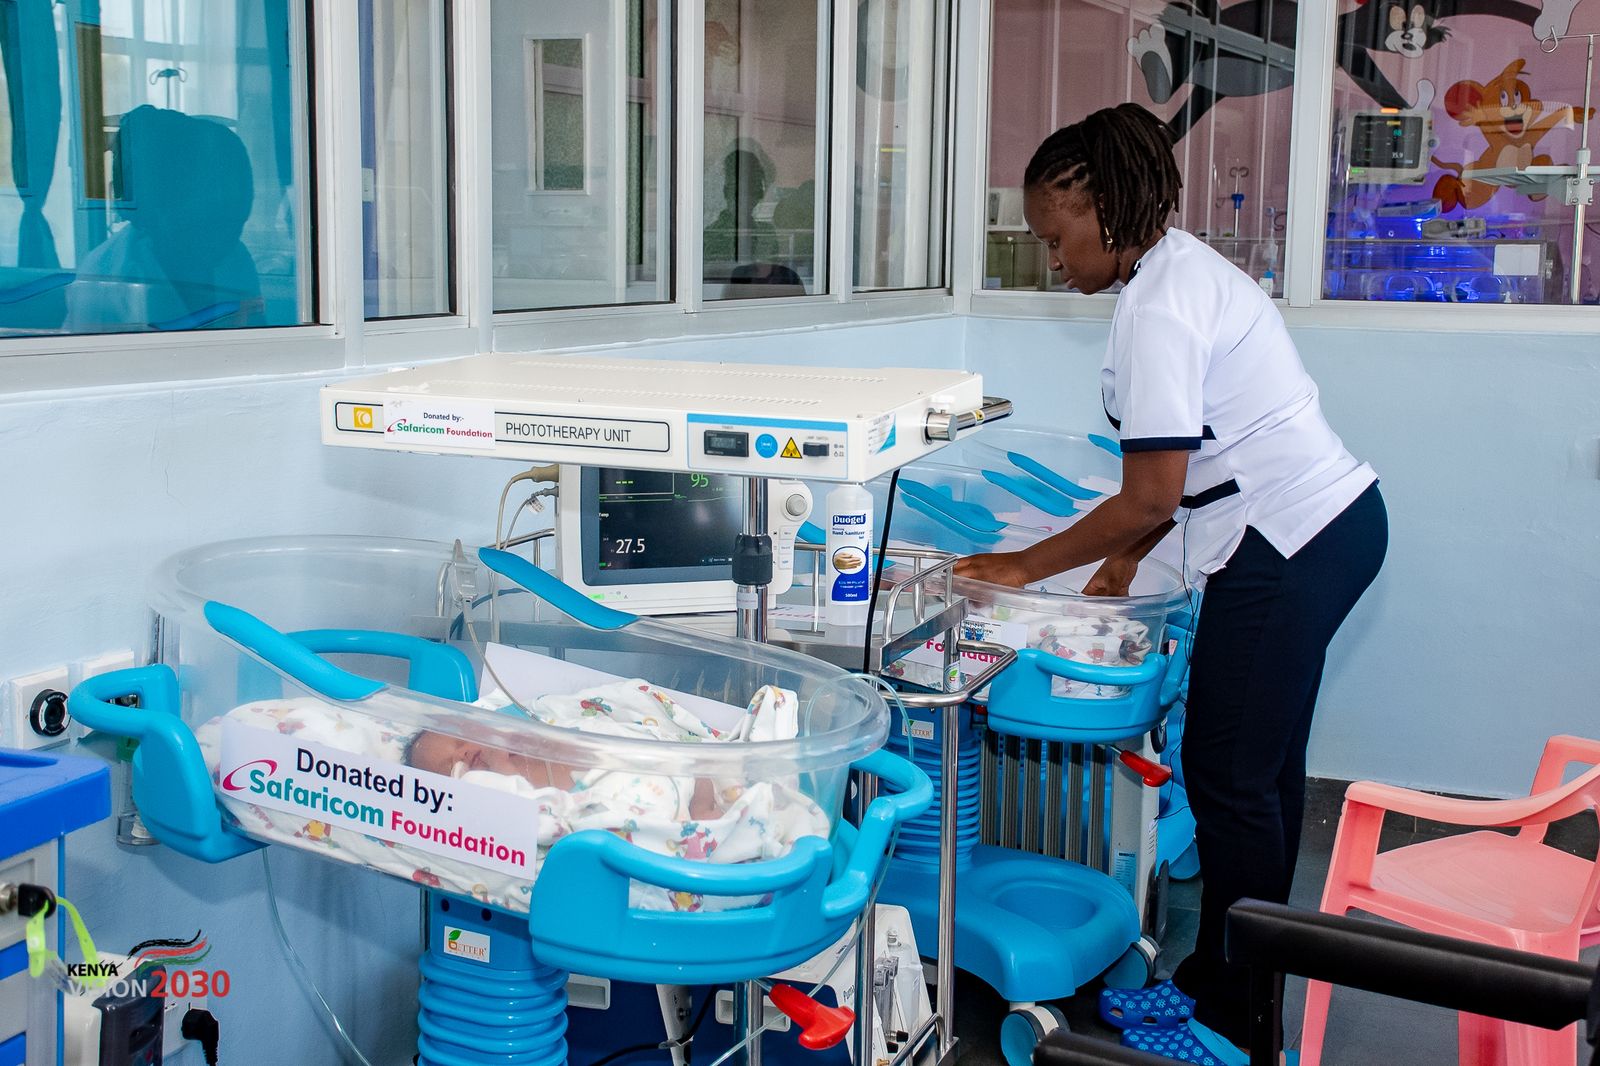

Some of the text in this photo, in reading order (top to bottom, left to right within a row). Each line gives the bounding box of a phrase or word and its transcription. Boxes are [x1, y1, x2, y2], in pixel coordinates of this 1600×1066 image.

[423, 412, 450, 421] Donated
[397, 422, 493, 438] Safaricom Foundation
[505, 422, 632, 443] PHOTOTHERAPY UNIT
[690, 472, 709, 488] 95
[833, 515, 864, 525] Duogel
[615, 538, 646, 554] 27.5
[297, 748, 454, 814] Donated by:
[249, 769, 526, 867] Safaricom Foundation
